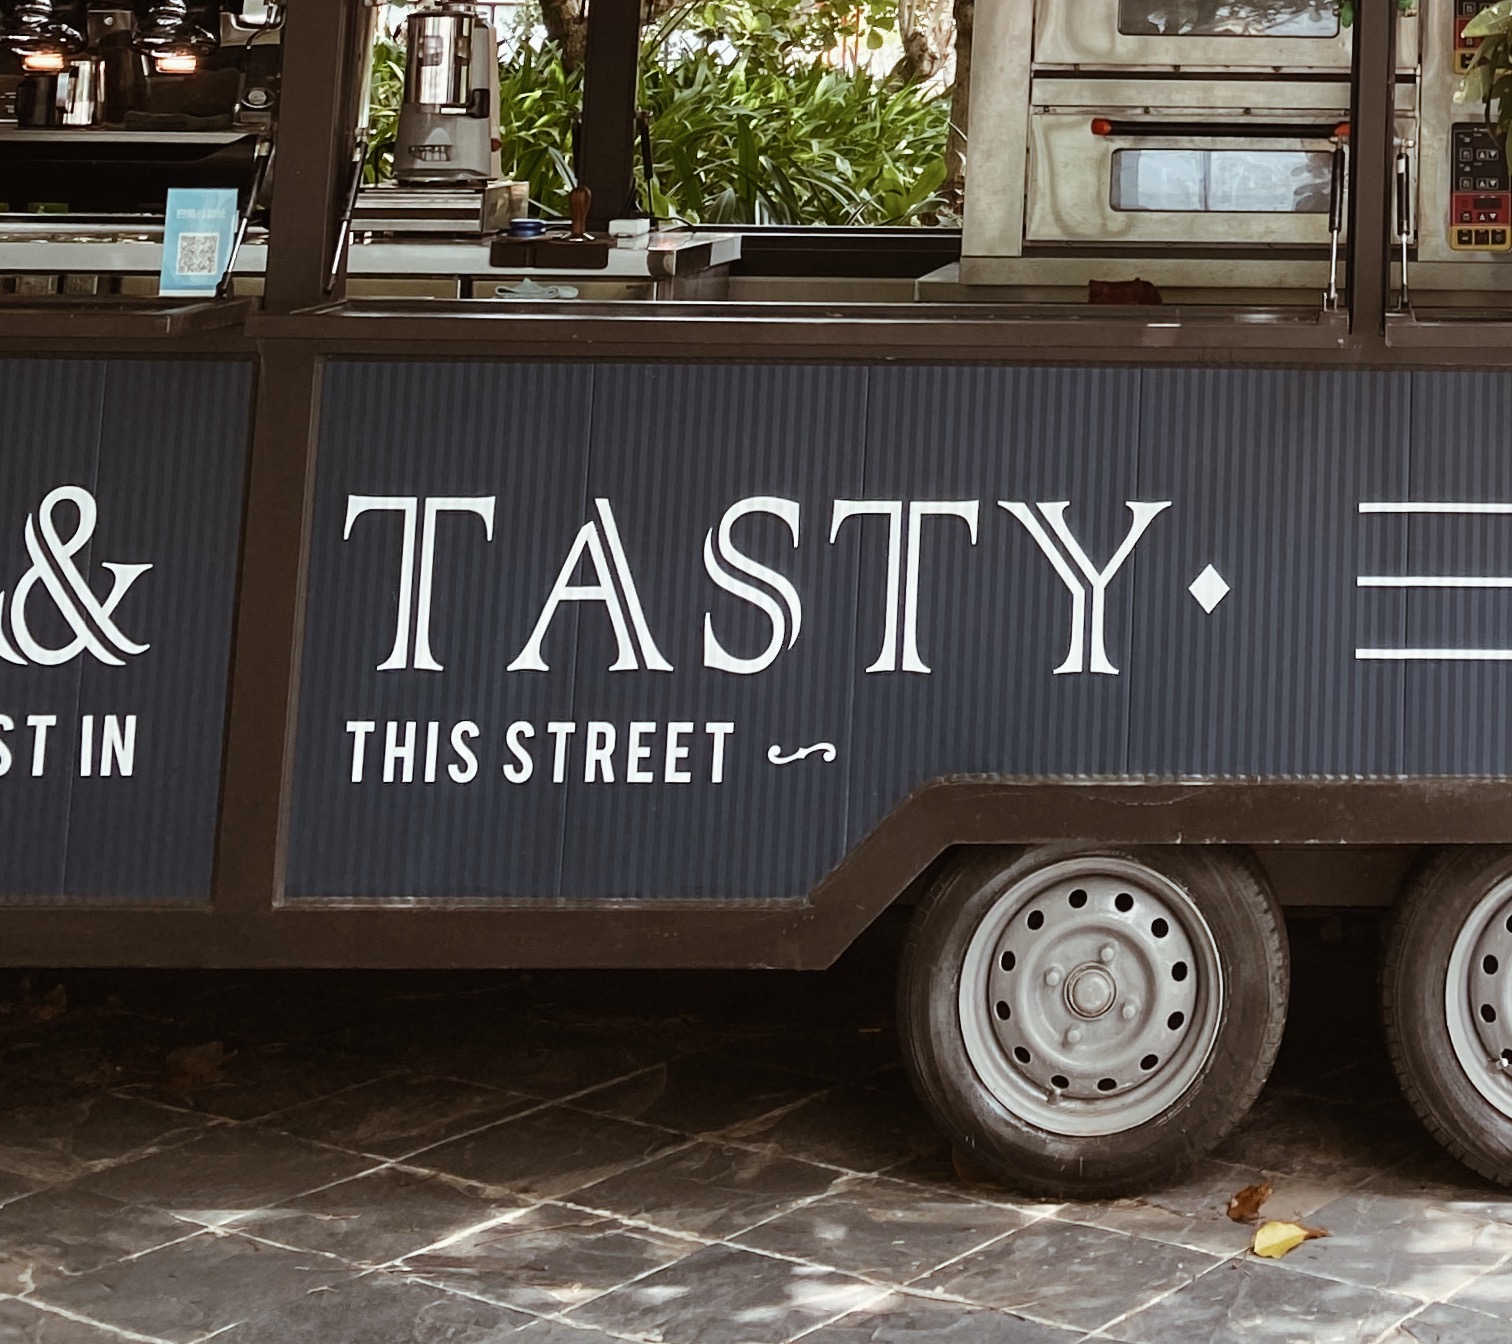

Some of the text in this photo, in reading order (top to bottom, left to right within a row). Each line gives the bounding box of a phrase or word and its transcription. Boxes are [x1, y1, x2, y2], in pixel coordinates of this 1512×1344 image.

[0, 486, 154, 666] &
[344, 495, 1173, 675] TASTY
[80, 714, 137, 777] IN
[346, 720, 735, 784] THIS STREET
